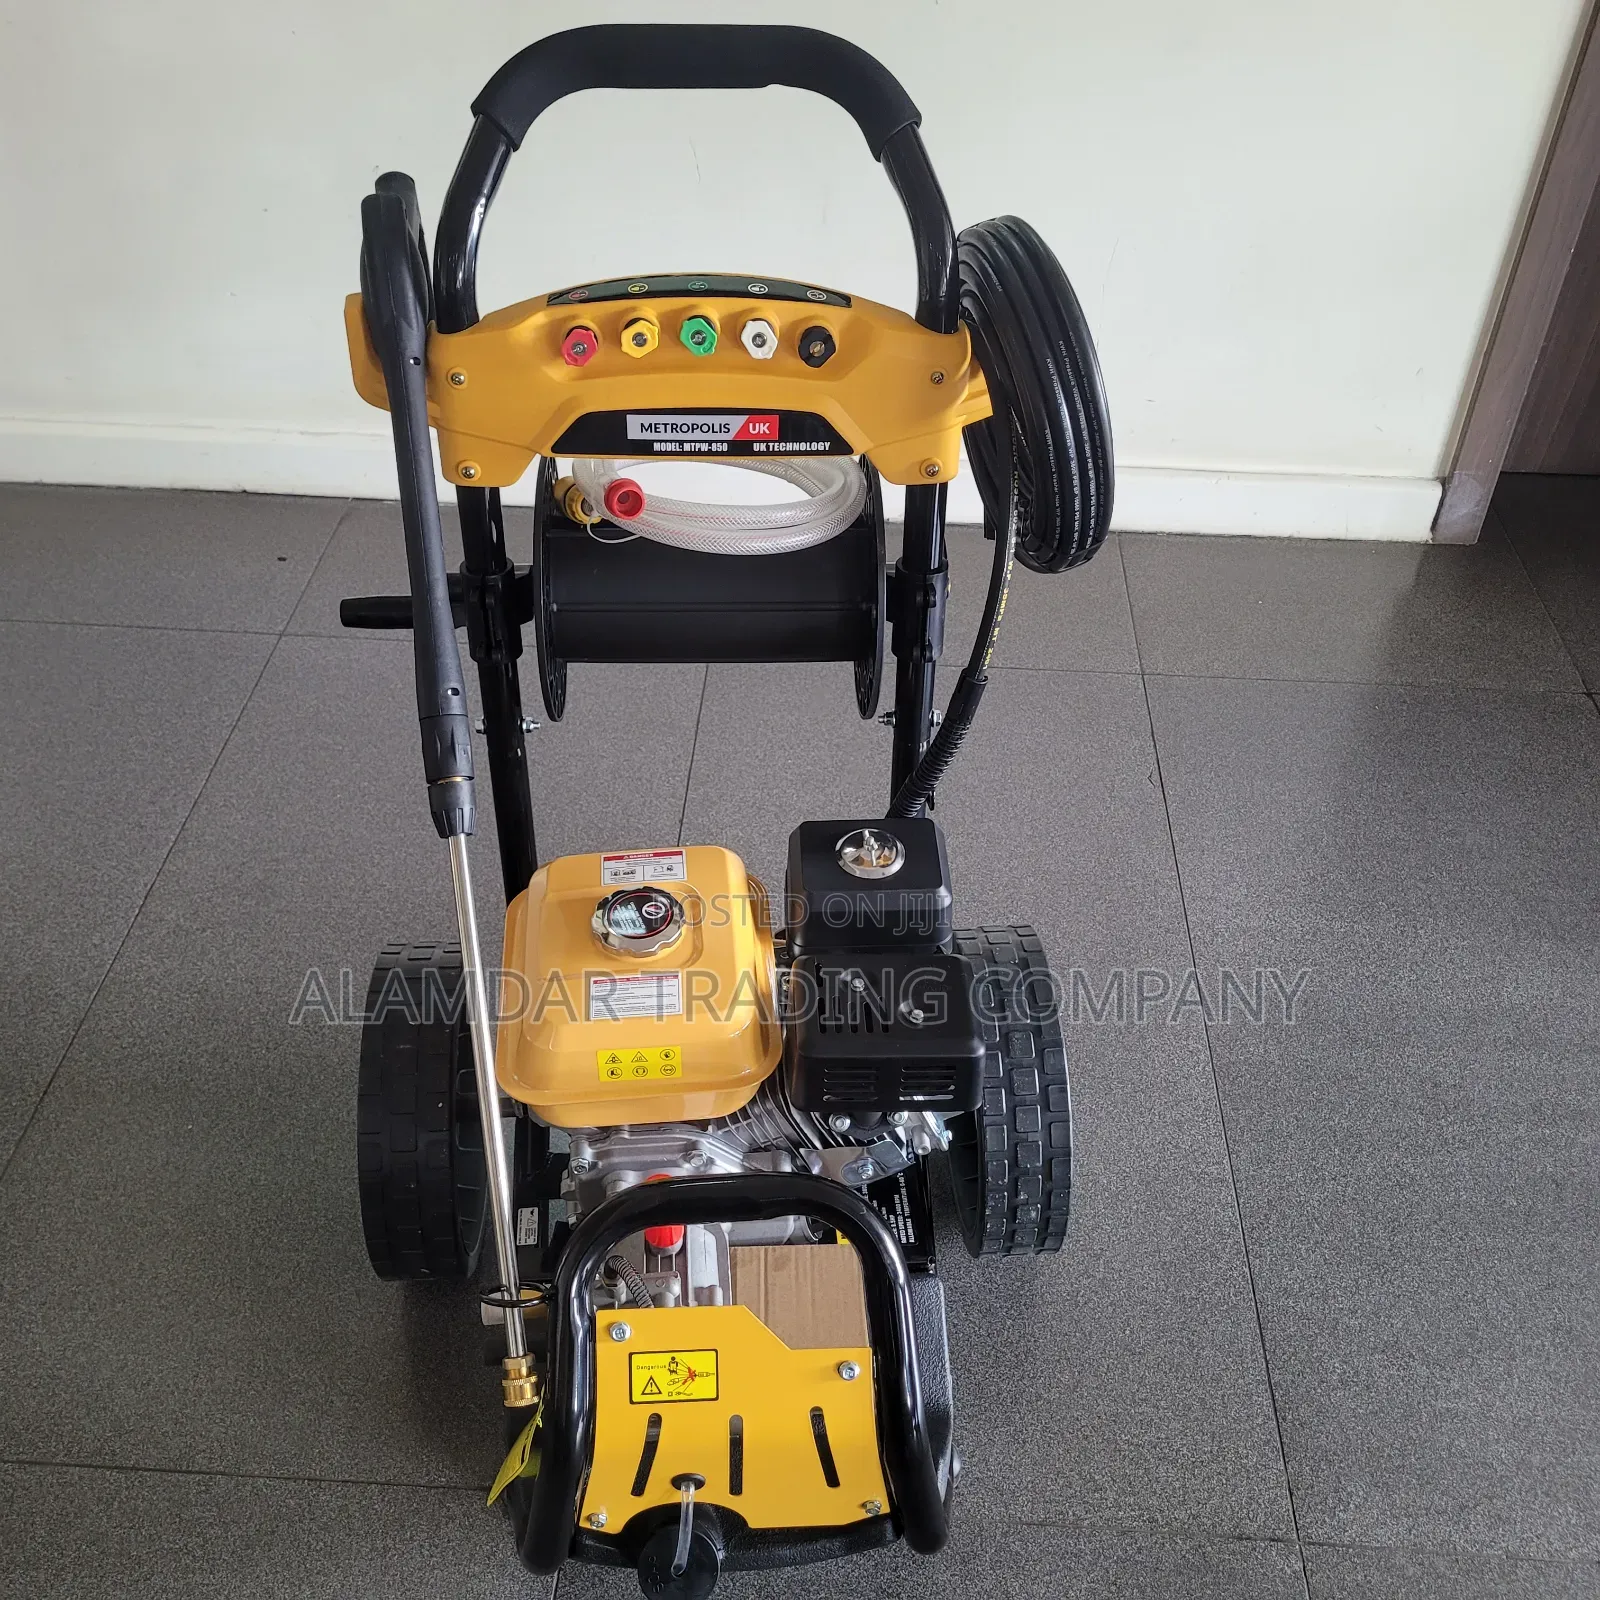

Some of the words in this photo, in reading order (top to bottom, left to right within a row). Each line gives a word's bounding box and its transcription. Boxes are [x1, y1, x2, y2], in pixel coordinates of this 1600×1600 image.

[1057, 340, 1067, 356] KWH
[1064, 356, 1075, 386] Pressure
[1072, 386, 1080, 410] Washer
[1051, 375, 1061, 404] Pressure
[639, 422, 731, 434] METROPOLIS
[748, 422, 771, 434] UK
[653, 442, 683, 452] MODEL:
[752, 442, 767, 452] UK
[768, 441, 831, 452] TECHNOLOGY
